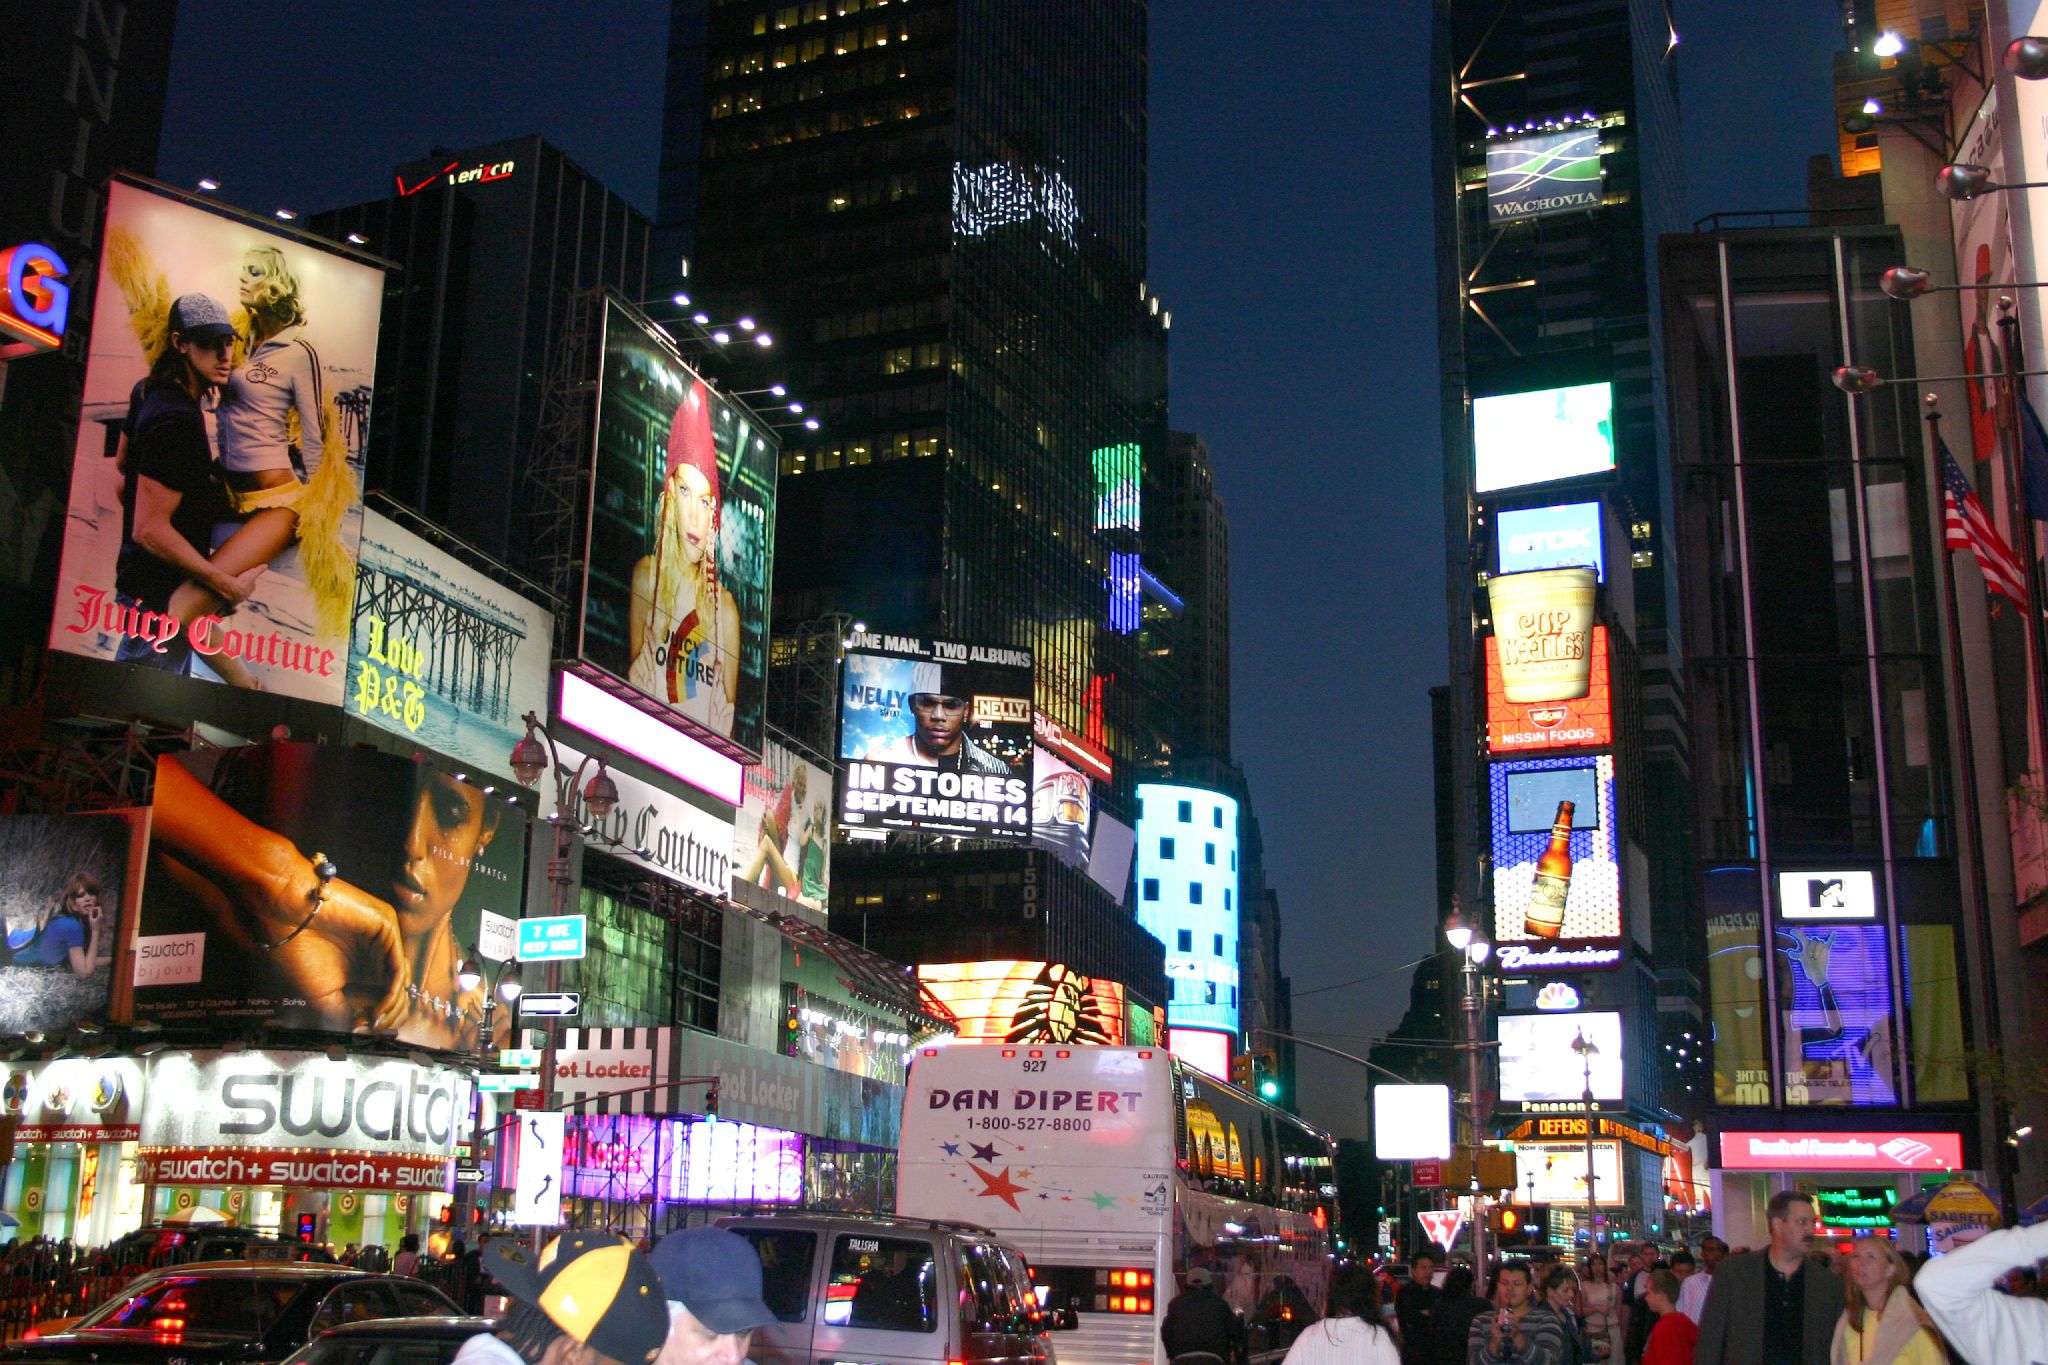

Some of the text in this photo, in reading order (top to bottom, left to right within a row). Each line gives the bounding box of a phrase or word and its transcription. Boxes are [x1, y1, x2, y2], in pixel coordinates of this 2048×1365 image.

[1493, 192, 1599, 216] WACHOVIA
[65, 585, 336, 677] Juicy Couture
[1519, 609, 1571, 638] CUP
[367, 615, 425, 680] Love
[850, 632, 881, 649] ONE
[933, 641, 967, 660] TWO
[970, 646, 1031, 668] ALBUMS
[851, 684, 906, 708] NELLY
[980, 701, 1024, 717] NELLY
[1503, 728, 1595, 744] NISSIN FOODS
[848, 762, 1027, 804] IN STORES
[846, 790, 1027, 825] SEPTEMBER 14
[635, 804, 729, 890] Couture
[475, 862, 507, 881] SWATCH
[532, 924, 571, 938] 7 AVE
[141, 940, 194, 958] swatch
[139, 964, 192, 979] bijoux
[282, 998, 306, 1007] SoHo
[586, 1060, 650, 1078] Locker
[1023, 1060, 1047, 1073] 927
[751, 1068, 799, 1112] Locker
[929, 1089, 1143, 1114] DAN DIPERT
[1522, 1102, 1599, 1112] Panasonc
[96, 1128, 132, 1139] swatch
[967, 1117, 1092, 1132] 1-800-527-8800
[1539, 1119, 1594, 1135] DEFENS
[159, 1155, 244, 1180] swatch
[270, 1160, 375, 1184] swatch
[1930, 1211, 1994, 1222] SABRETT
[848, 1239, 879, 1252] TALISHA
